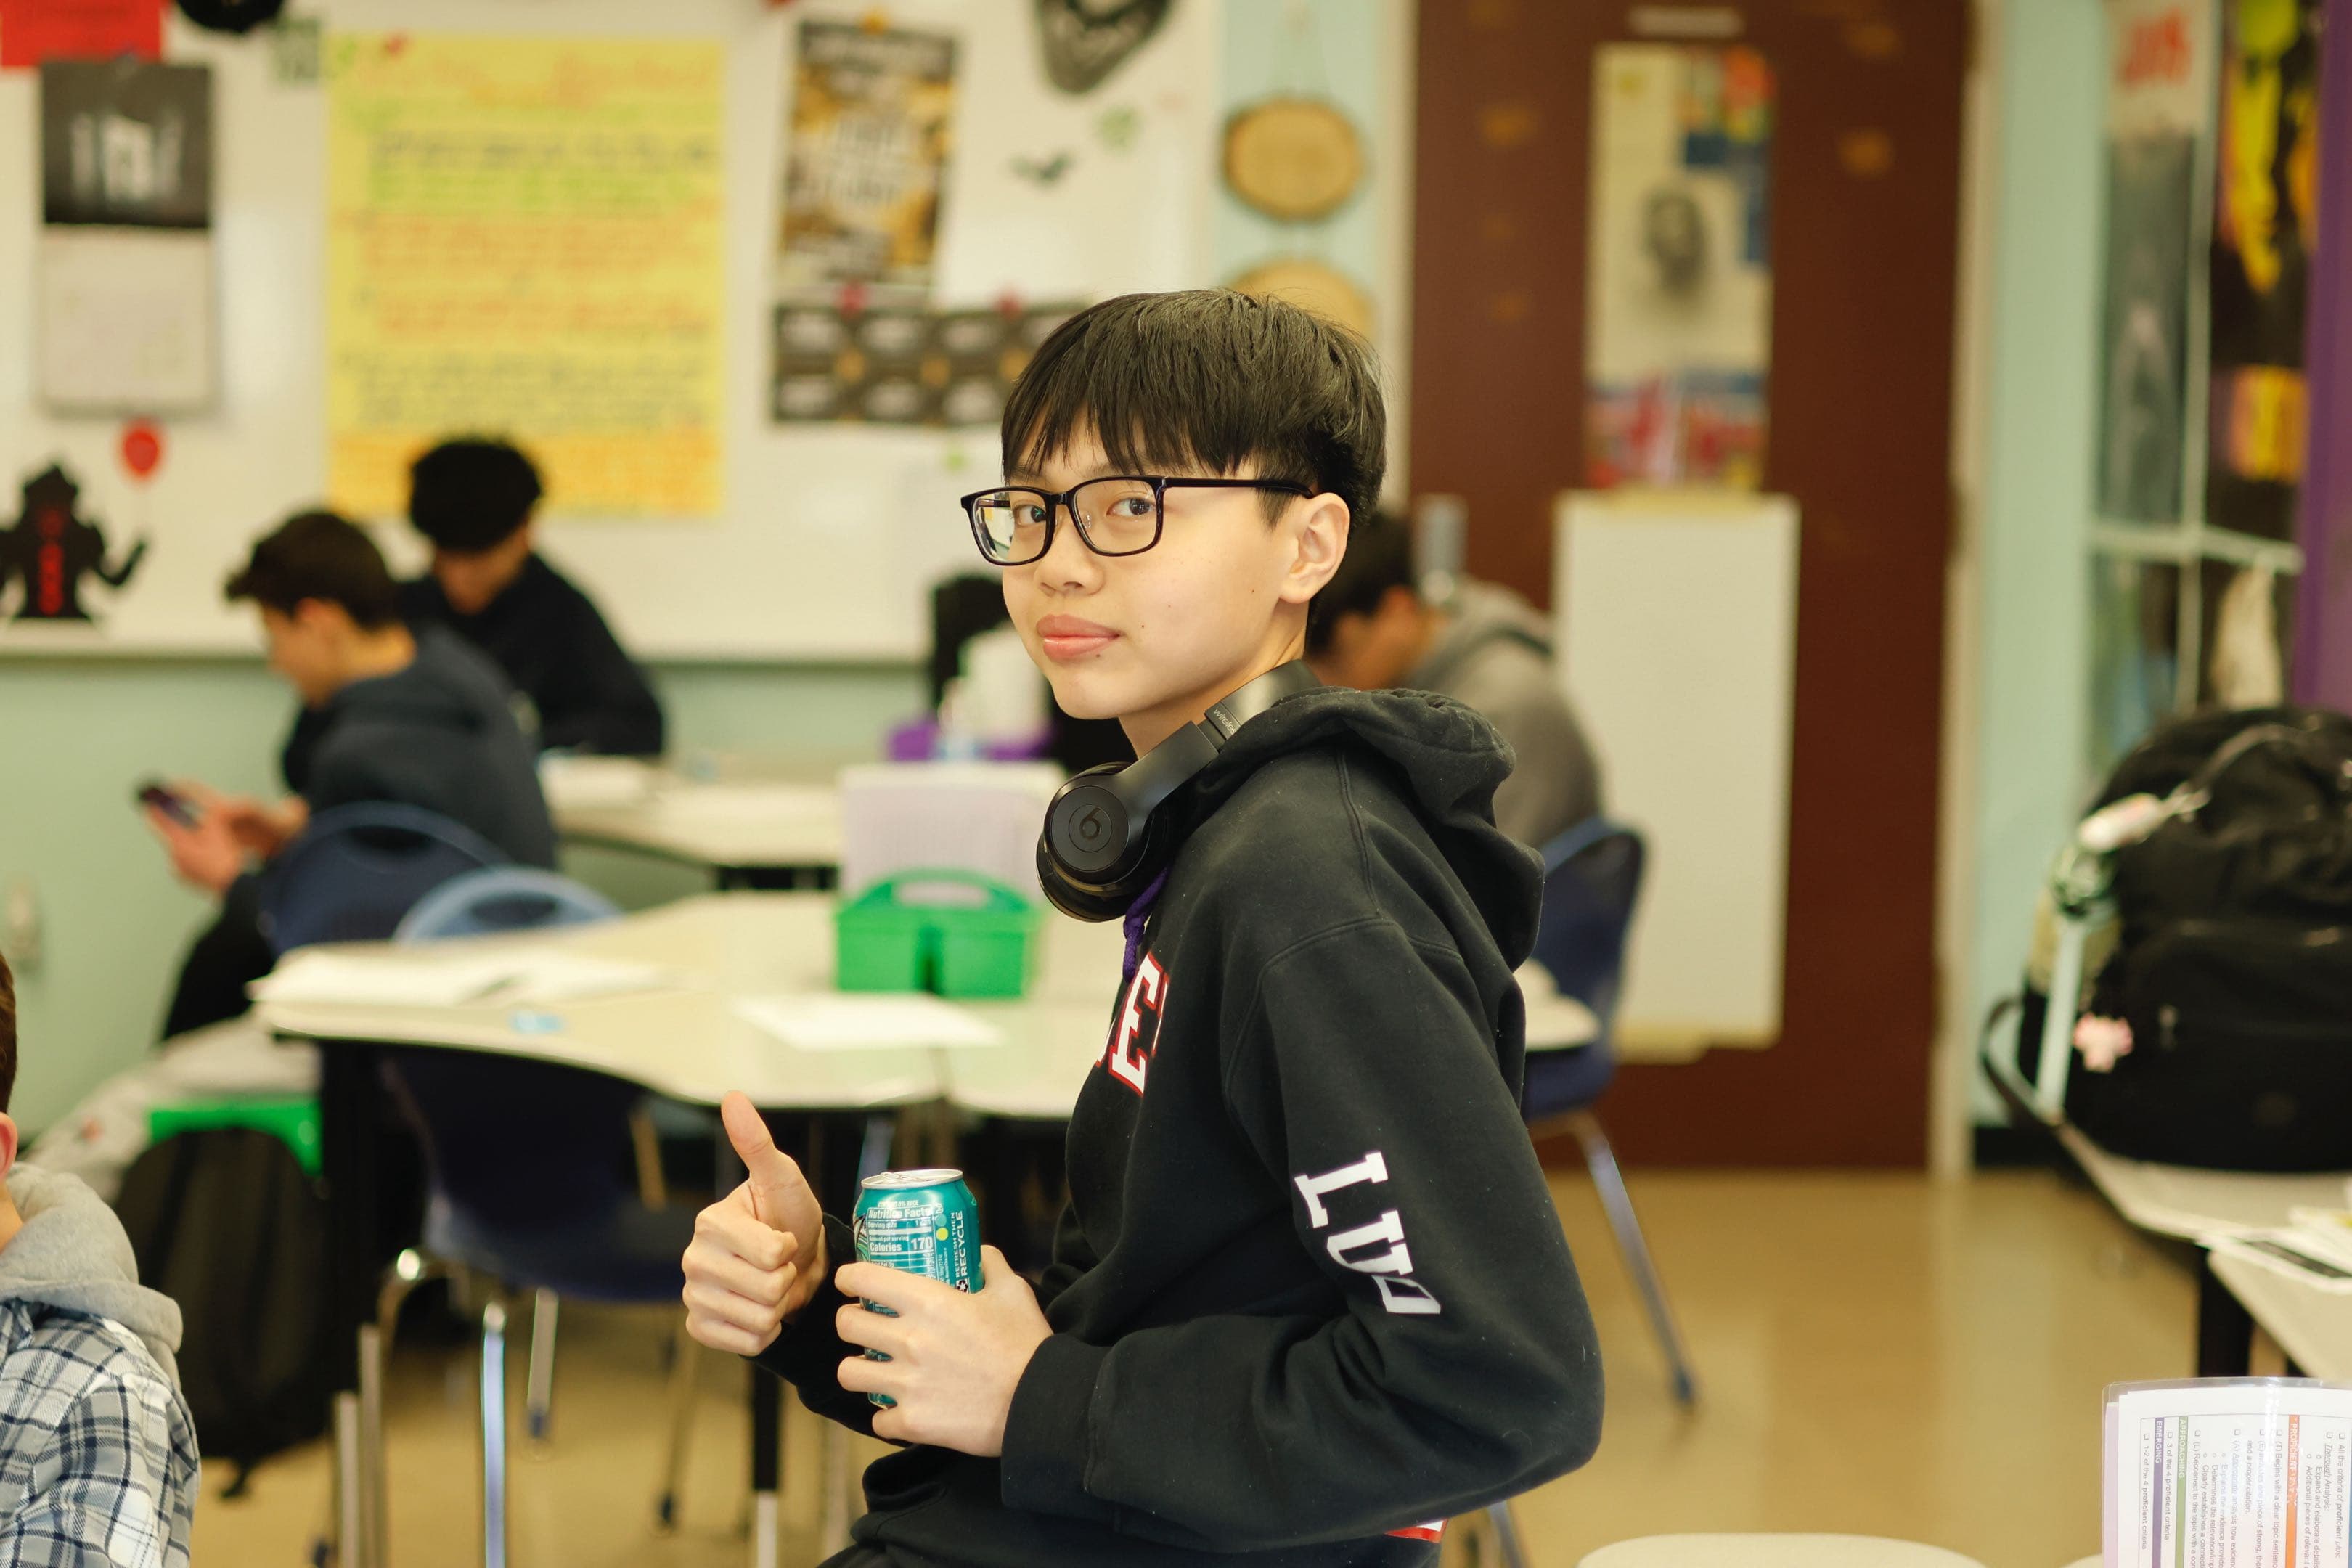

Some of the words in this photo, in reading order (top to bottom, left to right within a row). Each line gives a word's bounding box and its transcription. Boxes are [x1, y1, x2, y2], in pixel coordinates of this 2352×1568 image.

[1214, 708, 1237, 735] wireles
[905, 1206, 933, 1217] Facts
[870, 1242, 902, 1251] Calories
[911, 1237, 934, 1249] 170
[955, 1210, 968, 1277] RECYCLE
[2274, 1454, 2282, 1477] Begins
